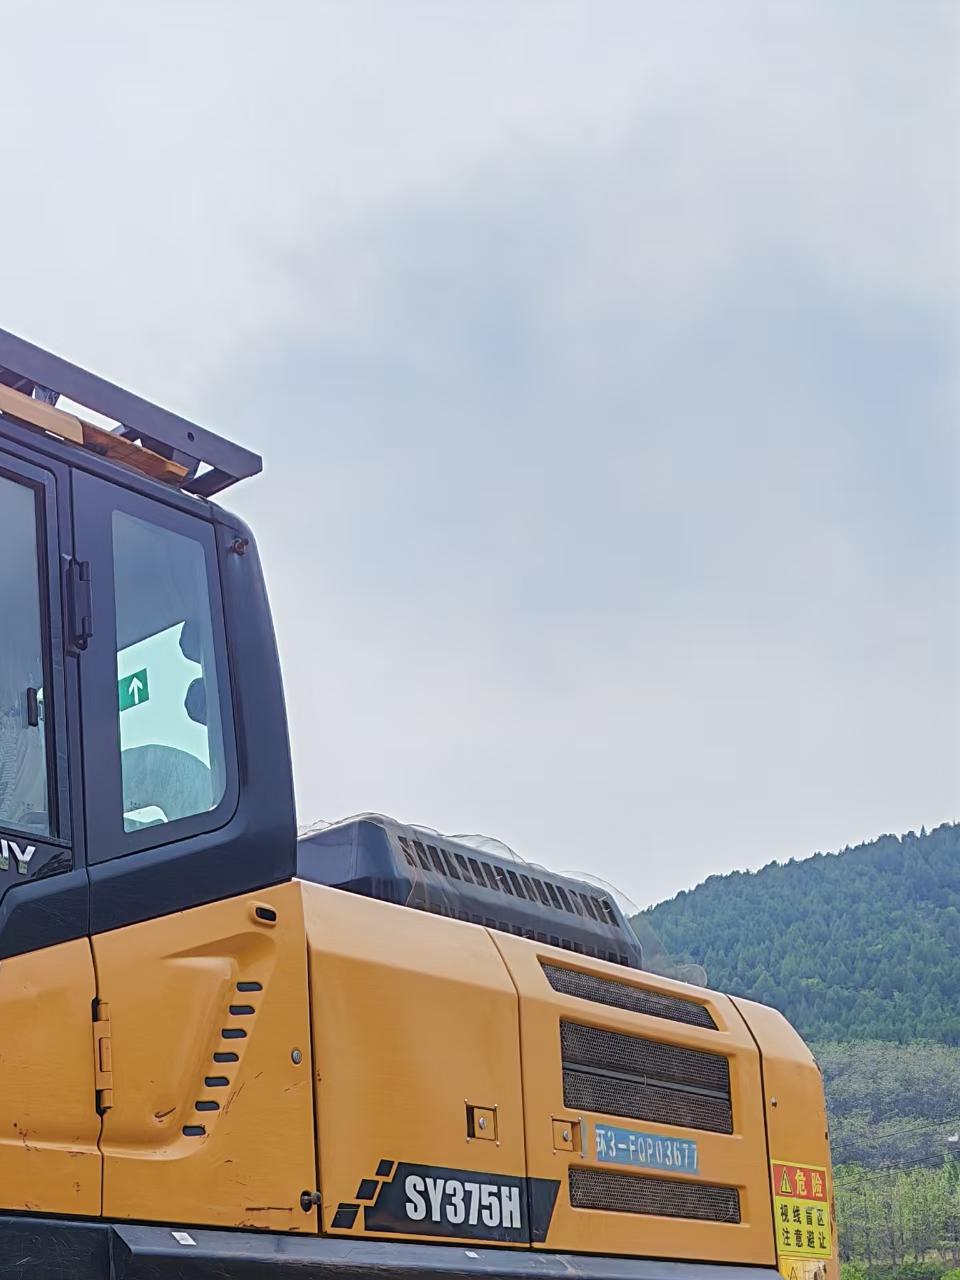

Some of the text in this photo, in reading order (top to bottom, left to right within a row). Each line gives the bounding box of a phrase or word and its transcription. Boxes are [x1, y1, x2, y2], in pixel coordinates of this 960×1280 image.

[795, 1169, 823, 1198] 危险
[405, 1175, 521, 1228] SY375H
[780, 1203, 825, 1227] 视线盲区
[782, 1227, 827, 1249] 注意避让
